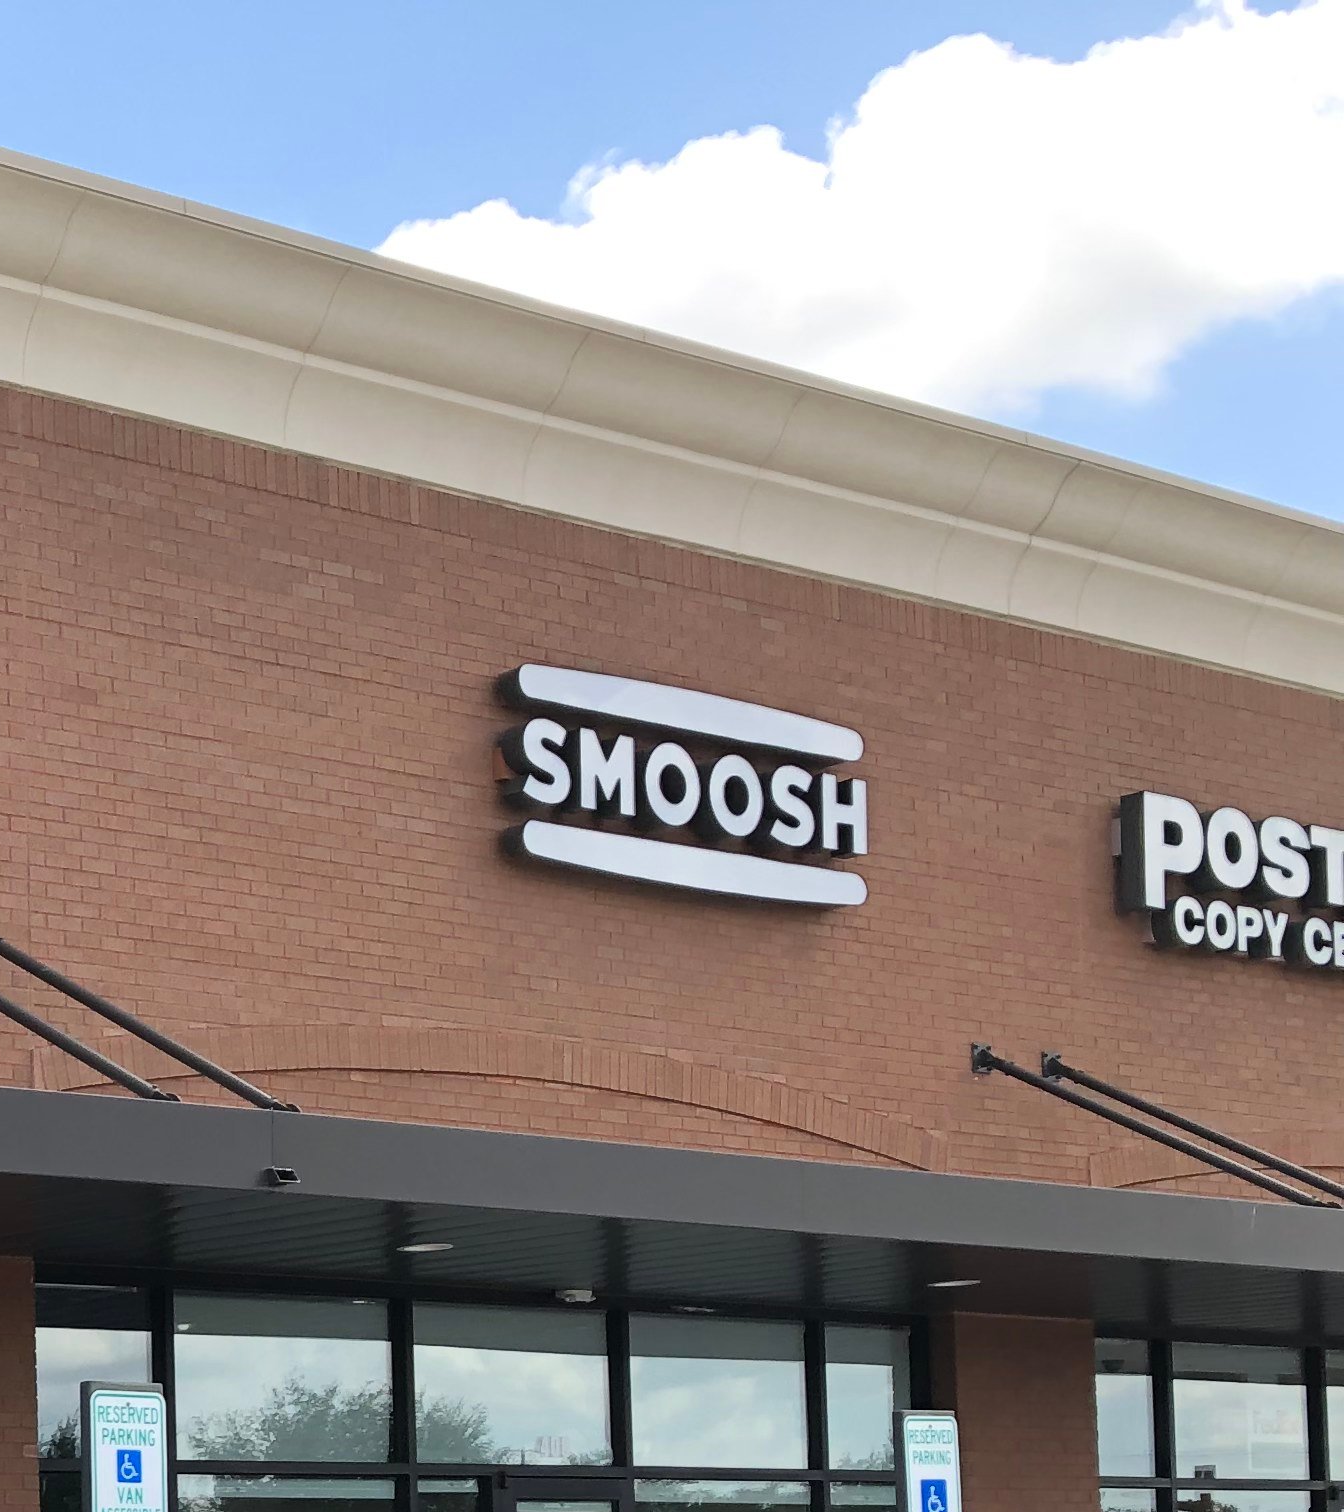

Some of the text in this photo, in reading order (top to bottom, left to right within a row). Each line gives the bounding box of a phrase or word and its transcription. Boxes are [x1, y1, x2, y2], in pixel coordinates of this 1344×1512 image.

[523, 717, 868, 855] SMOOSH
[1174, 895, 1289, 957] COPY
[98, 1405, 159, 1425] RESERVED
[102, 1428, 155, 1447] PARKING
[908, 1429, 953, 1444] RESERVED
[913, 1450, 952, 1465] PARKING
[117, 1487, 143, 1504] VAN
